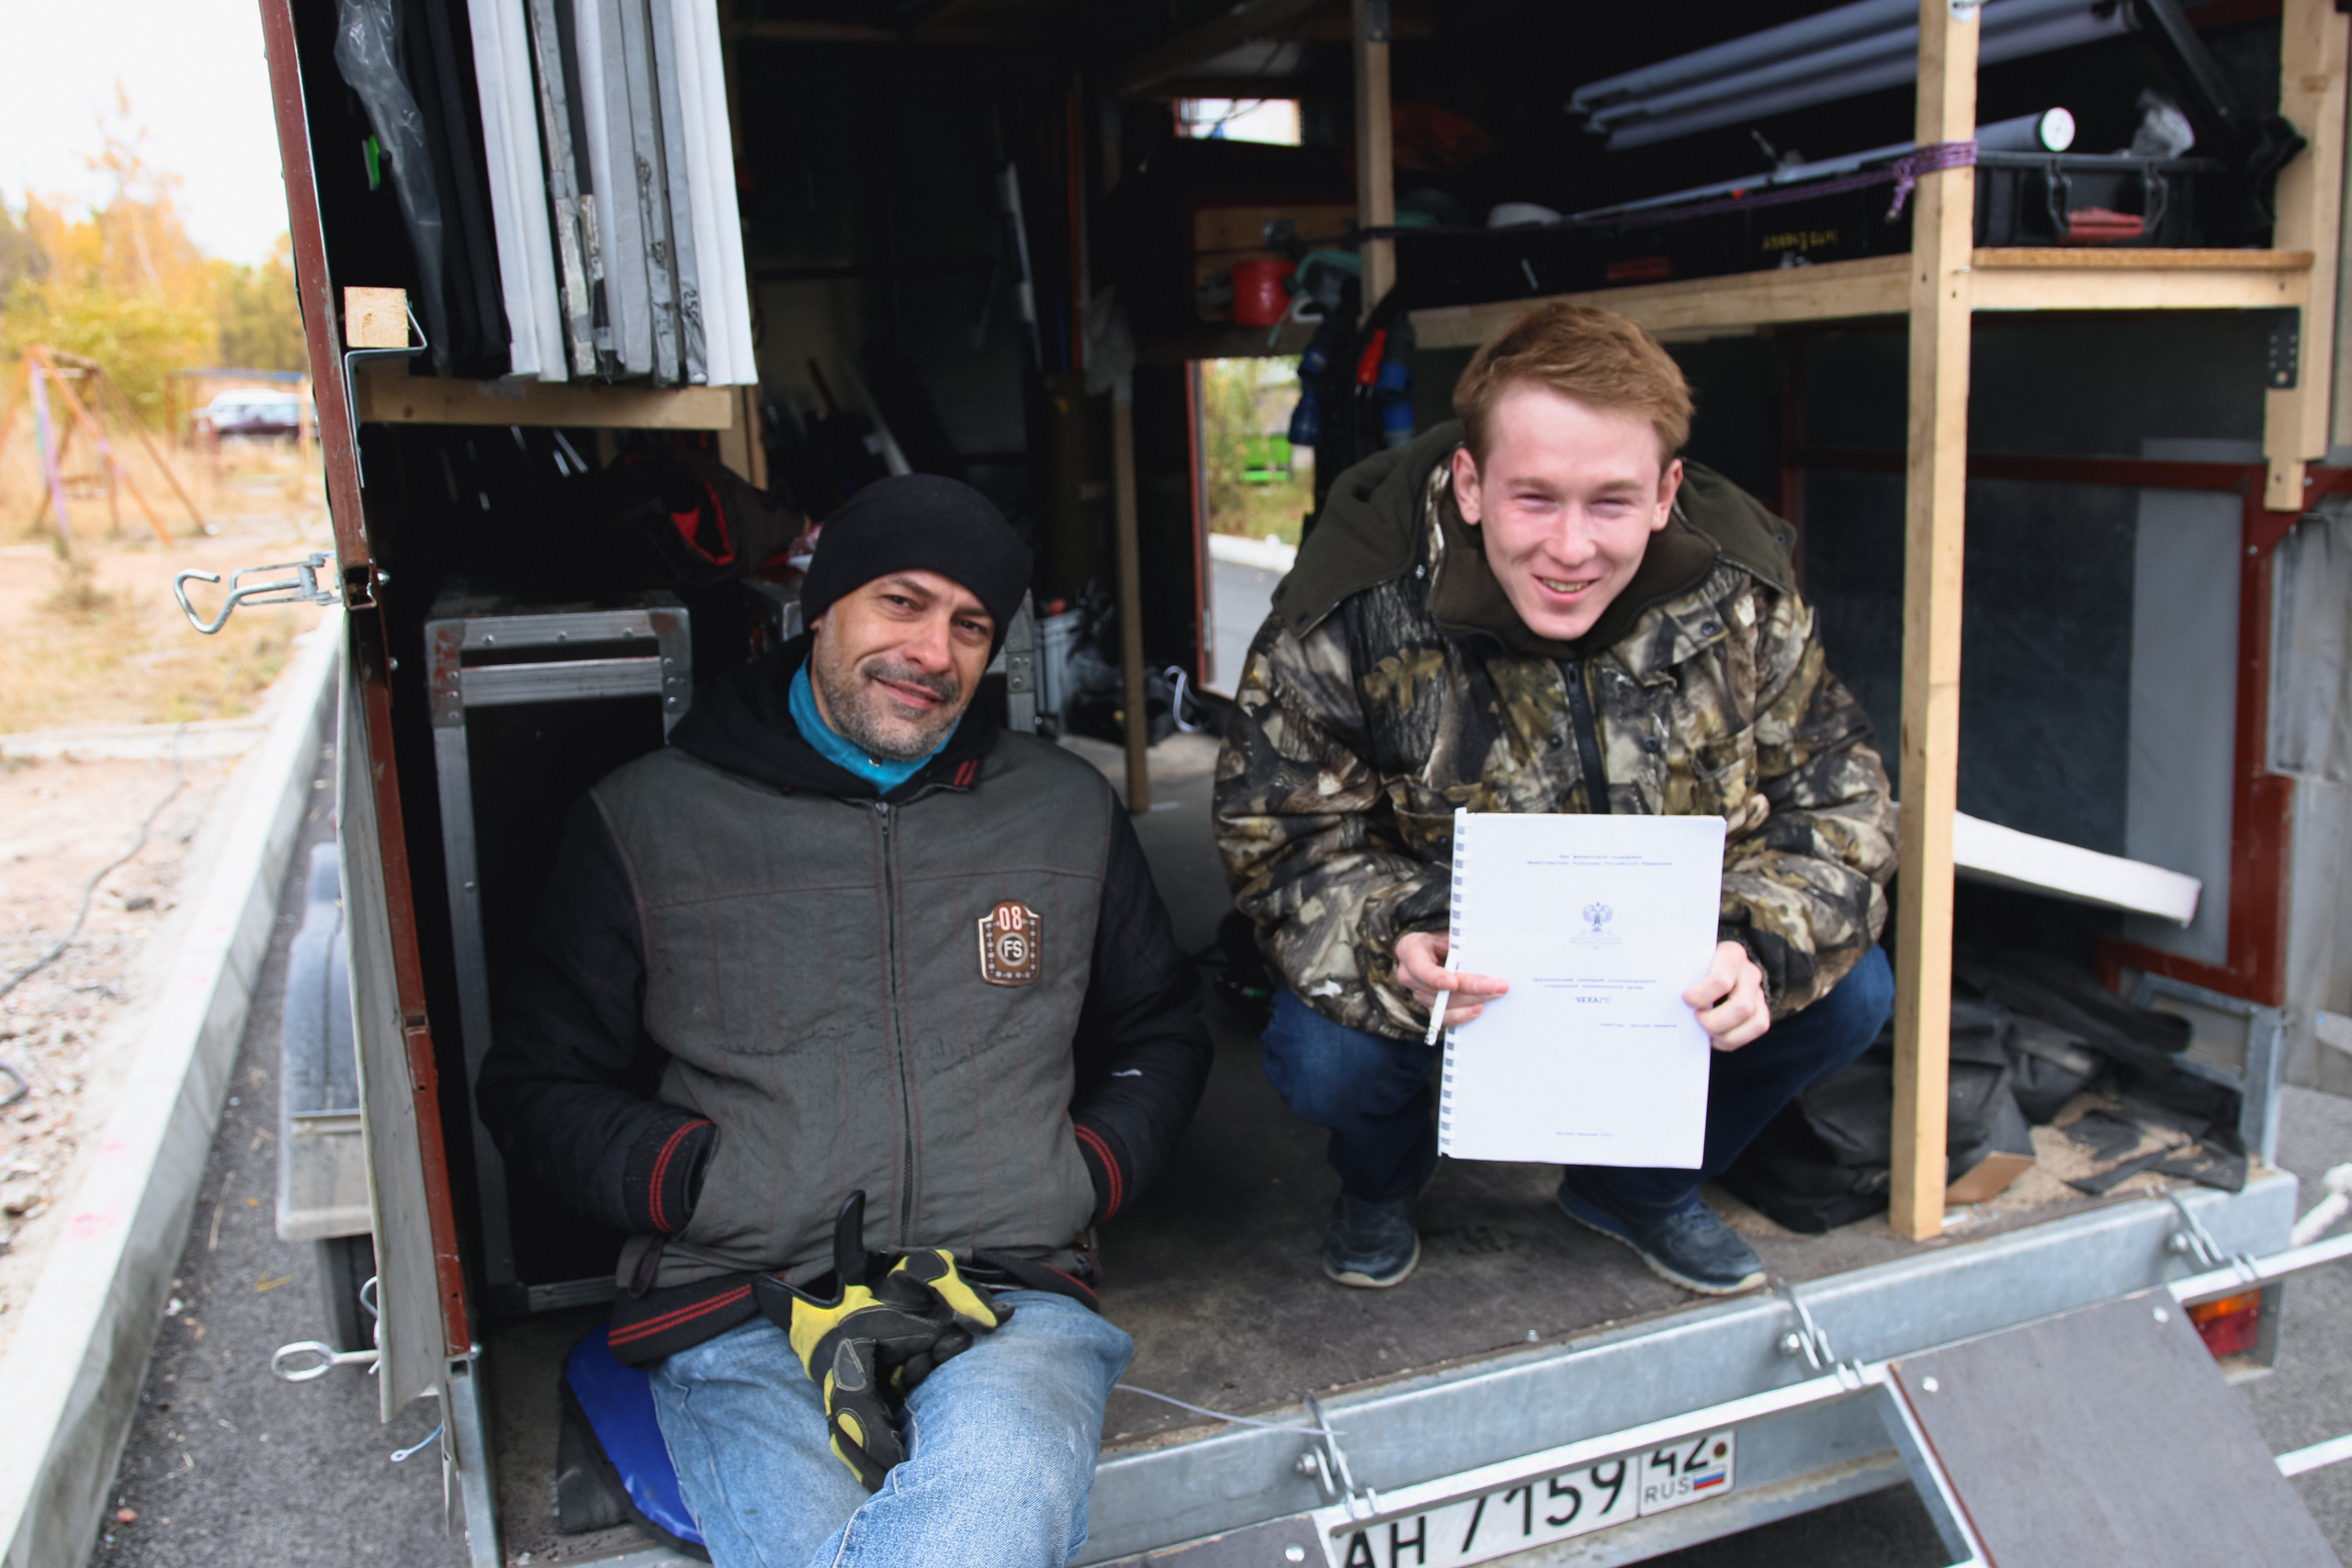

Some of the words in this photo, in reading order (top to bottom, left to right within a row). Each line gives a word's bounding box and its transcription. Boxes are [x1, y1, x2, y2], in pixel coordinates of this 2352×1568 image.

[999, 906, 1023, 931] 08
[1003, 940, 1023, 958] FS
[1645, 1475, 1690, 1504] RUS
